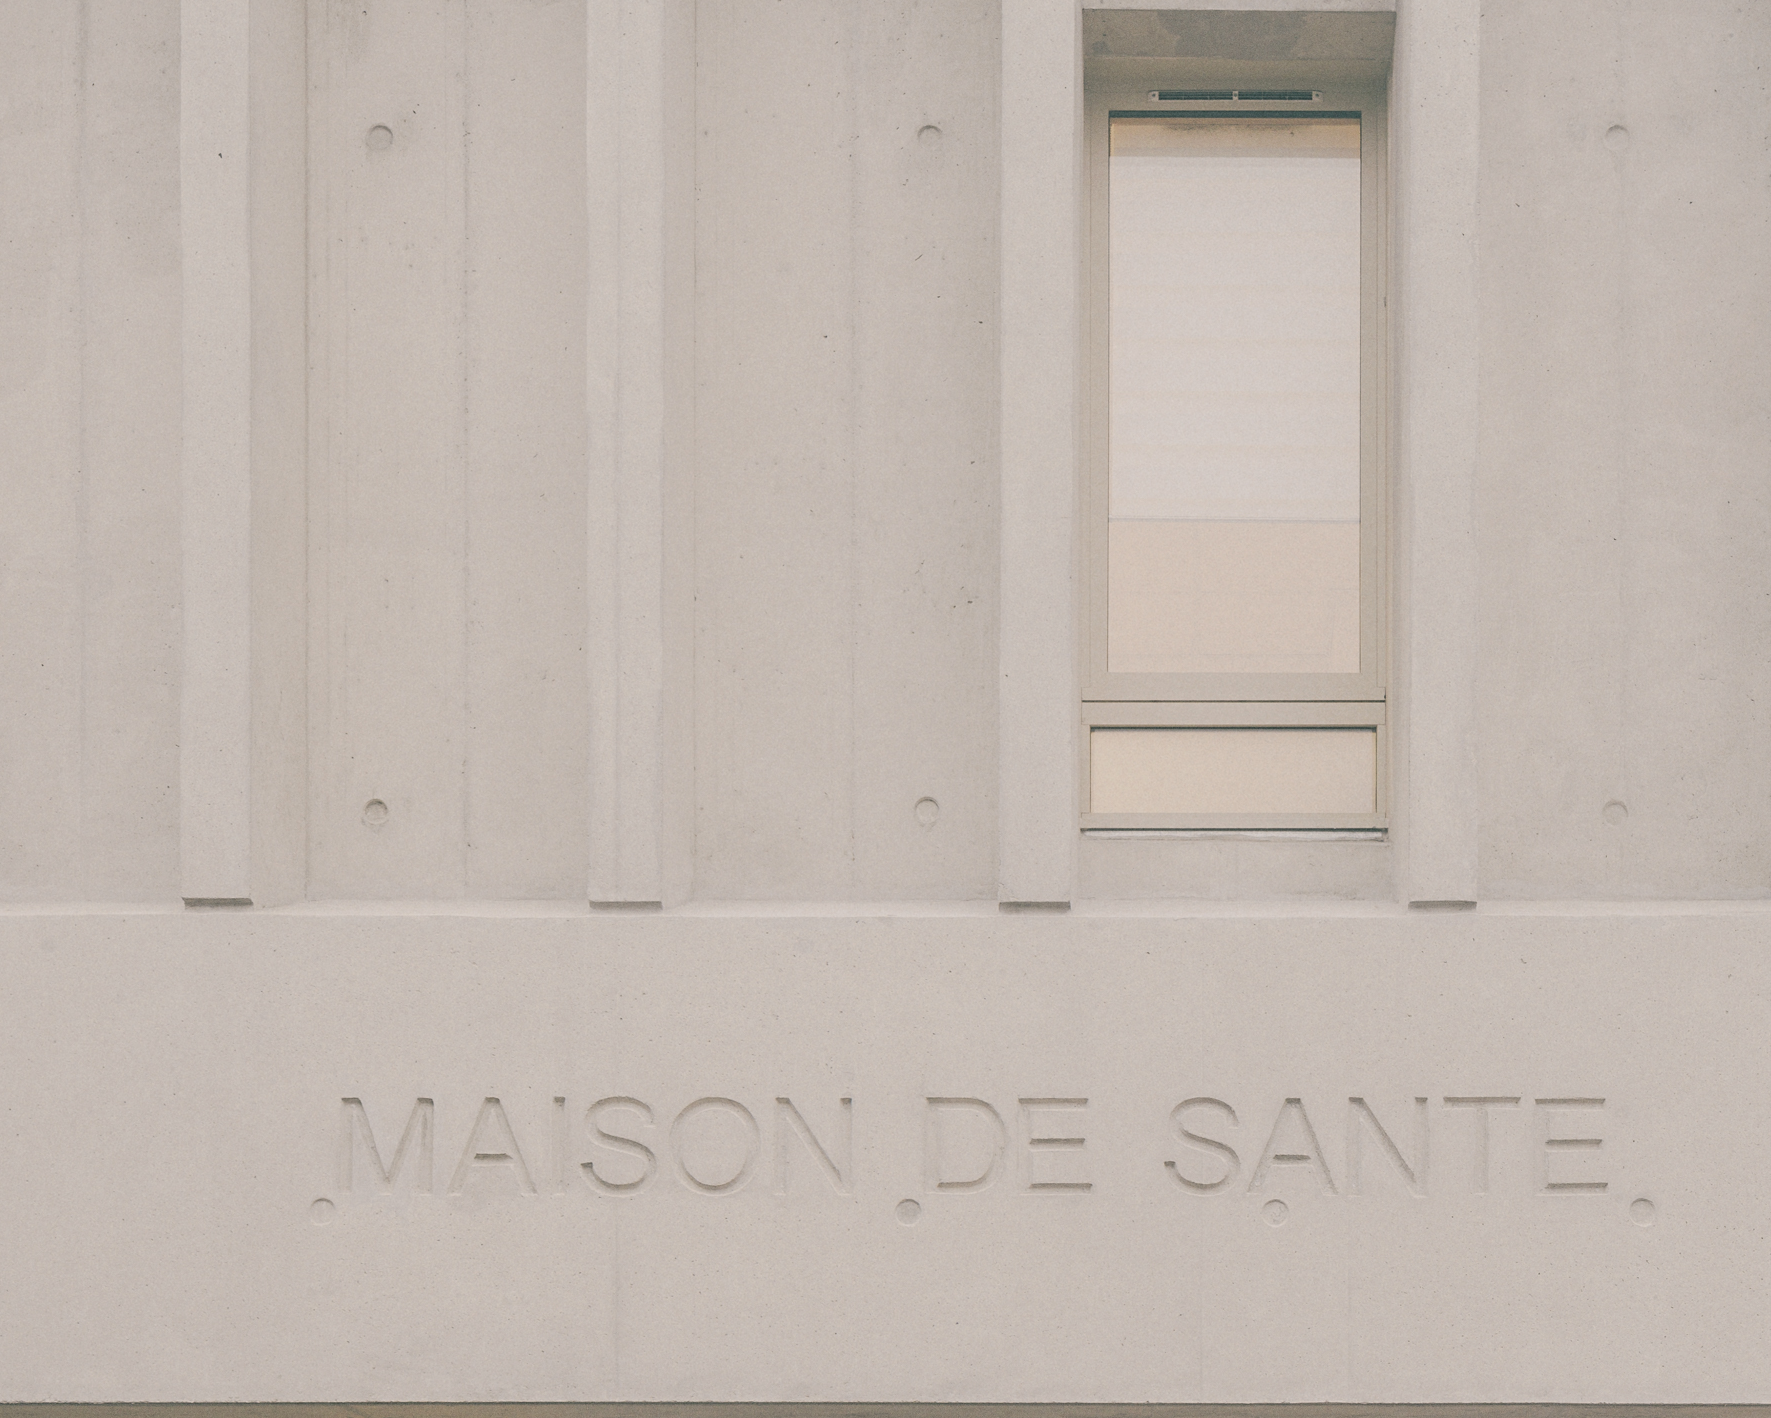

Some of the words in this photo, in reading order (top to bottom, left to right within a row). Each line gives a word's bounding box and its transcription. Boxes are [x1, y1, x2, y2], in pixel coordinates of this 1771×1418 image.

[337, 1096, 855, 1197] MAISON
[925, 1096, 1094, 1196] DE
[1163, 1096, 1610, 1198] SANTE
